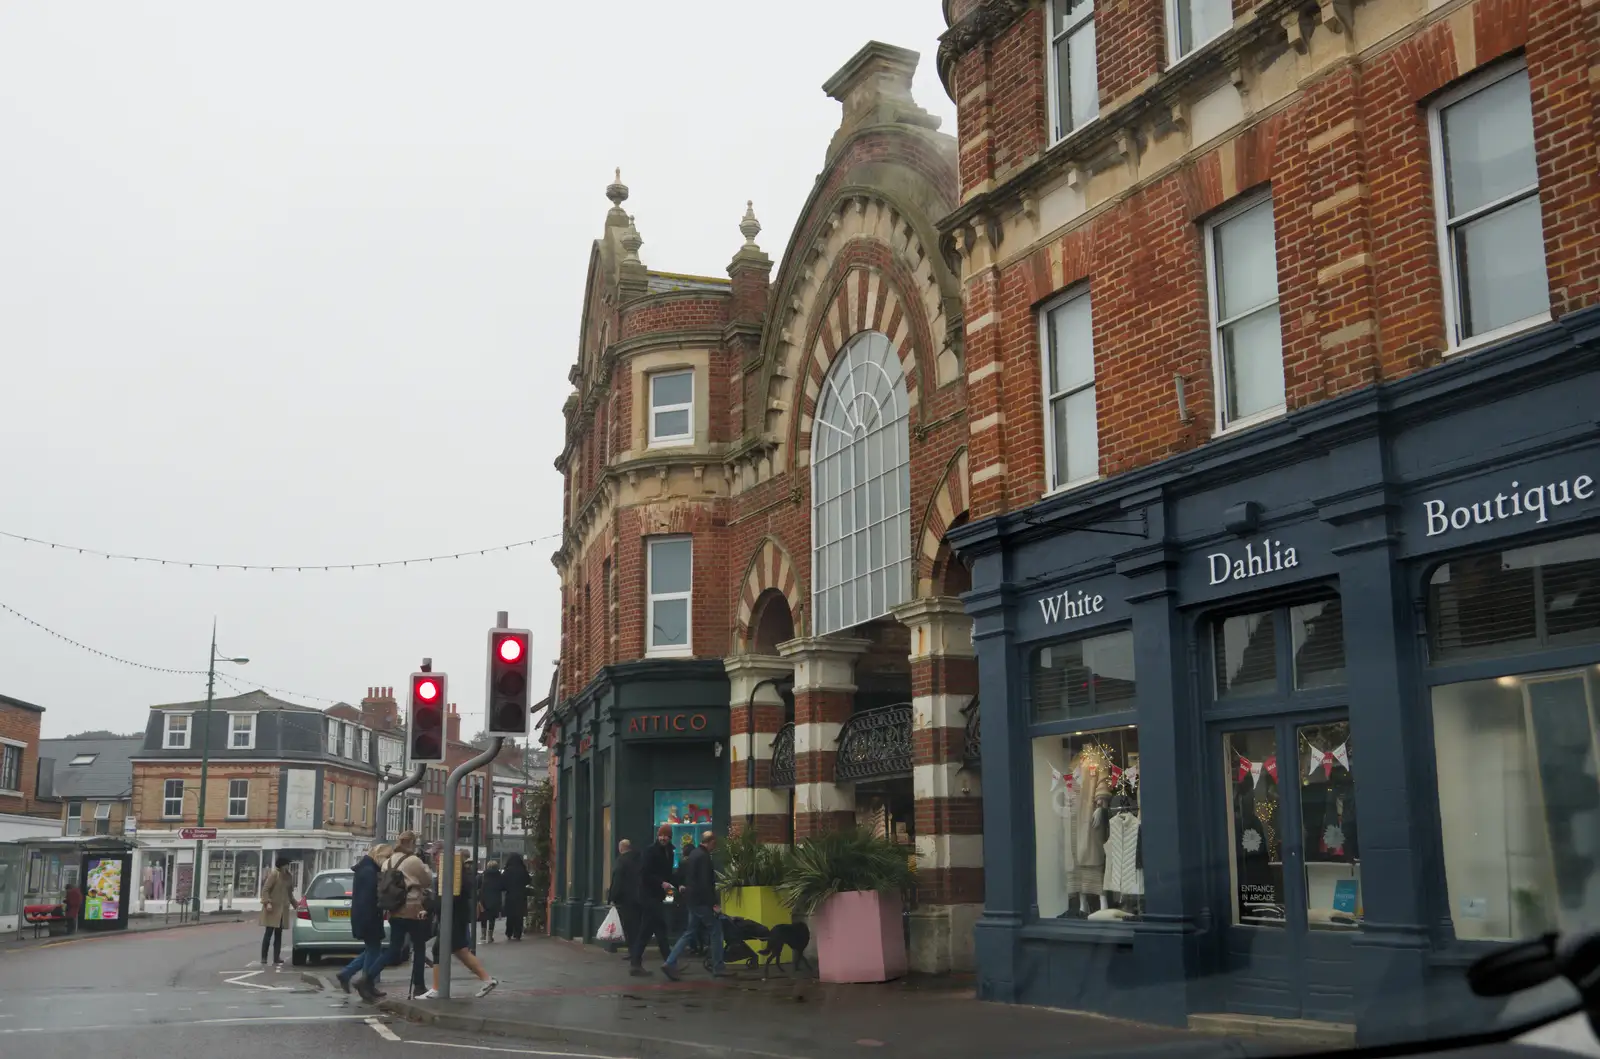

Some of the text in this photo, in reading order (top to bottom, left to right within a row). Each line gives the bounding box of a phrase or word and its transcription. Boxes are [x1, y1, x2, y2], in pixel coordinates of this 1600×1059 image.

[1038, 474, 1595, 625] White Dahlia Boutique
[628, 714, 708, 733] ATTICO
[1240, 763, 1250, 772] SALE
[1267, 763, 1277, 771] SALE
[1241, 884, 1275, 893] ENTRANCE
[1241, 893, 1276, 902] IN ARCADE
